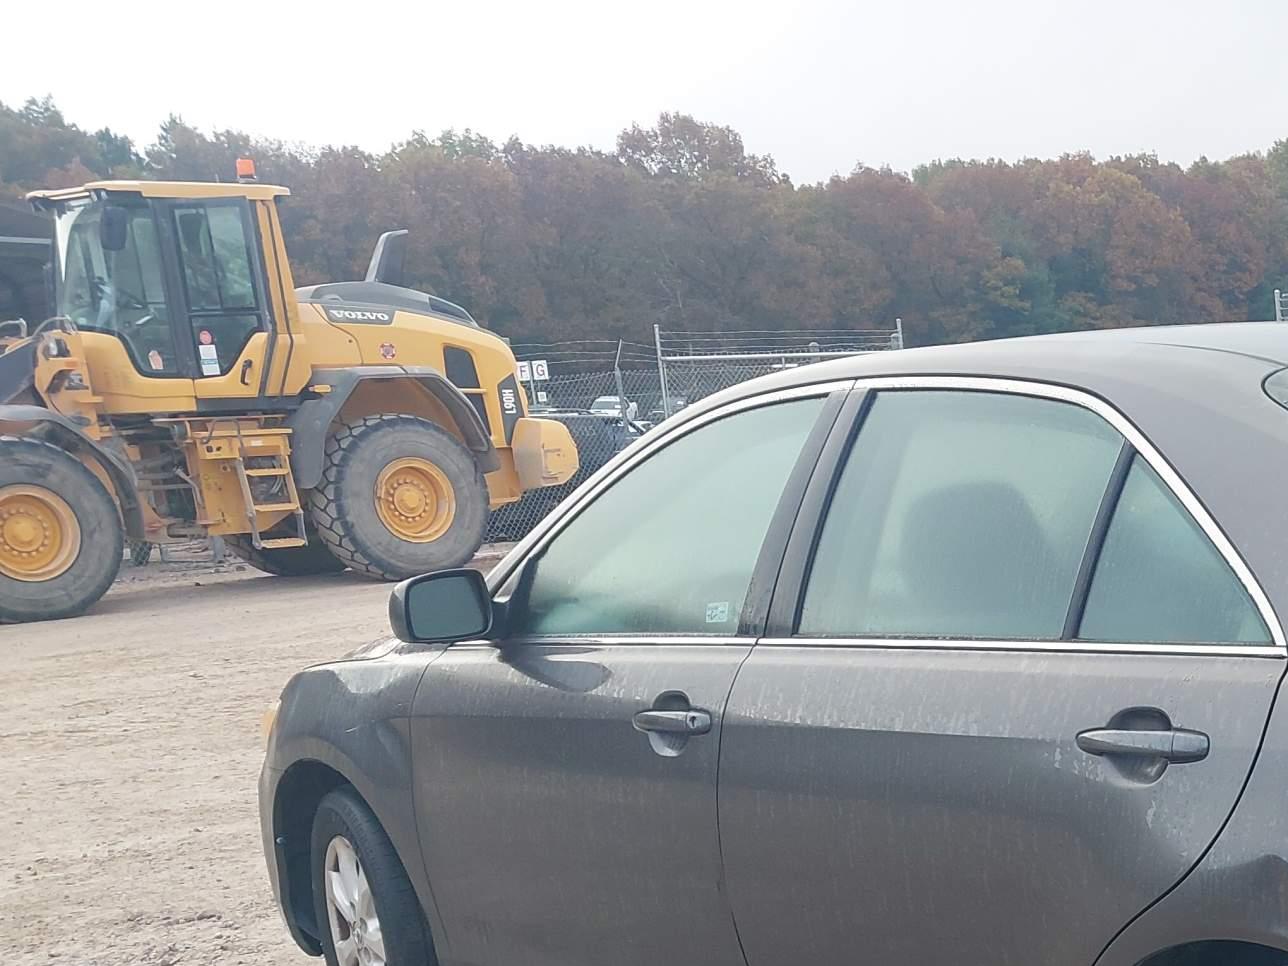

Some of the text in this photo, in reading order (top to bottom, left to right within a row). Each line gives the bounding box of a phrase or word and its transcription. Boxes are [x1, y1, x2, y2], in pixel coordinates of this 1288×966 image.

[329, 309, 390, 321] VOLVO
[519, 365, 527, 378] F
[535, 363, 546, 377] G
[501, 388, 517, 414] L90H
